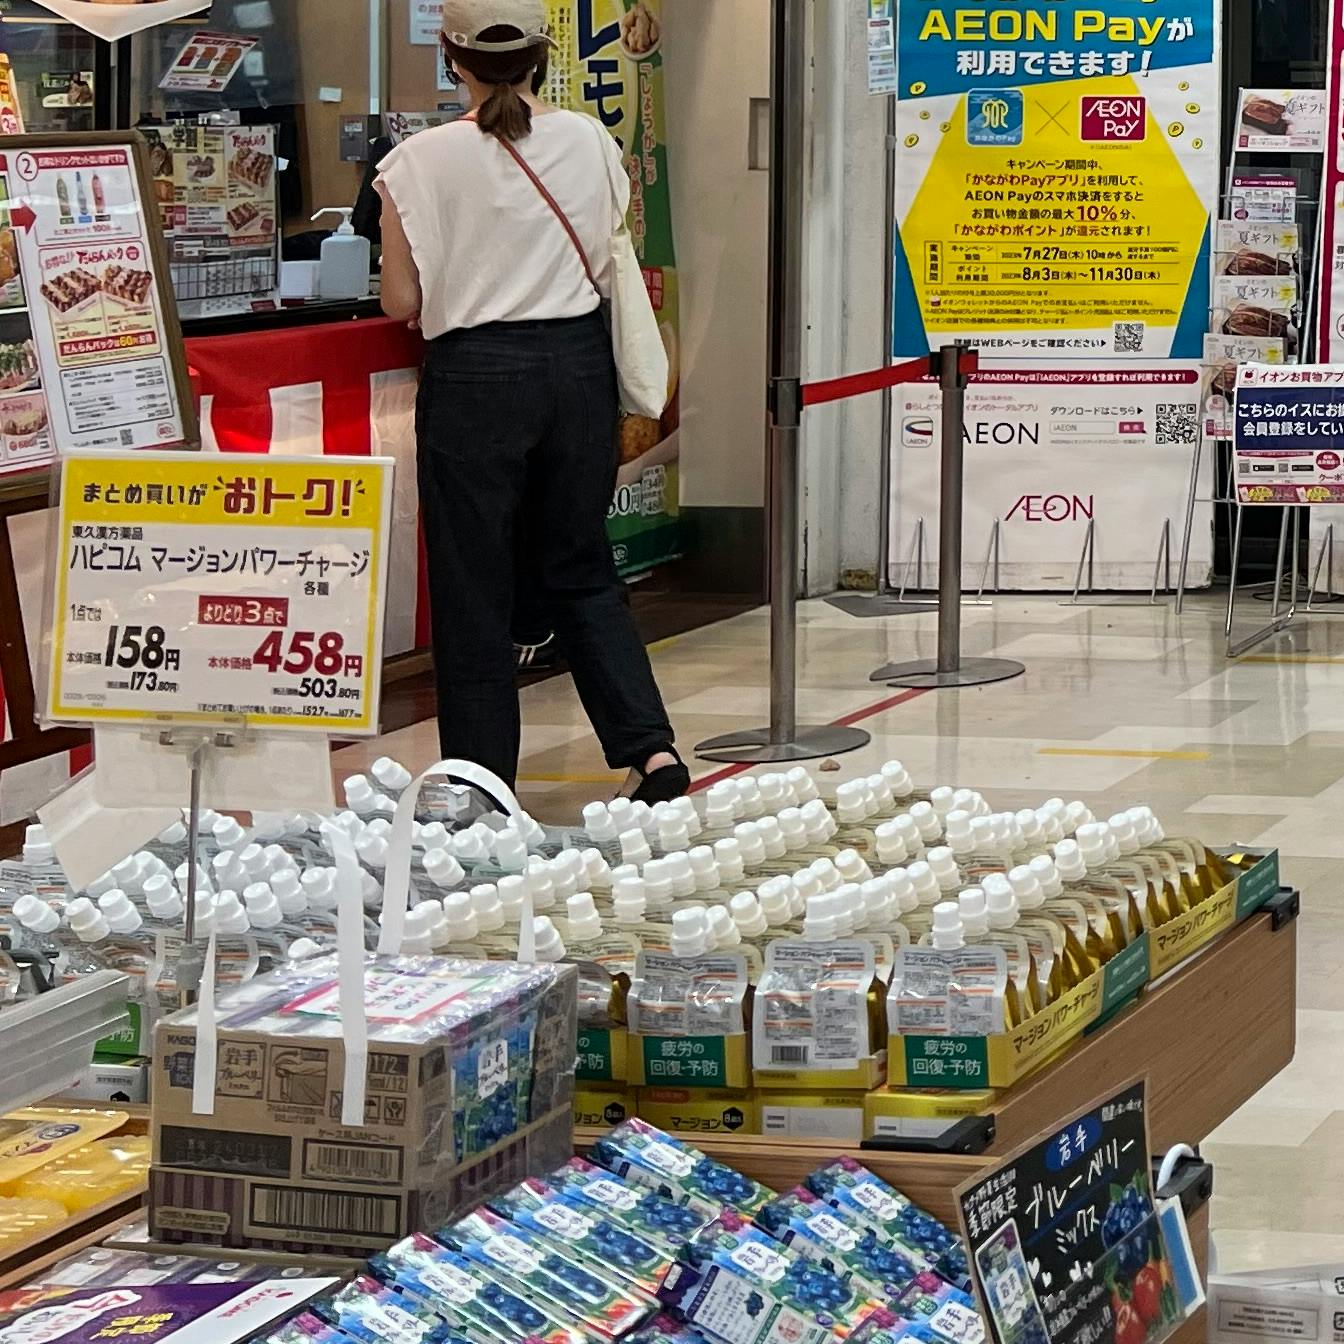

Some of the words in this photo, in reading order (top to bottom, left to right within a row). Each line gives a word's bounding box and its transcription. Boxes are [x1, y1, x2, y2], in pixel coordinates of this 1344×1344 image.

[918, 9, 1058, 42] AEON
[1073, 10, 1195, 46] Payが
[956, 49, 1153, 78] 利用できます!
[1084, 99, 1142, 120] AEON
[964, 190, 1004, 203] AEON
[1238, 230, 1279, 245] 夏ギフト
[1235, 284, 1276, 300] 夏ギフト
[1223, 344, 1264, 359] 夏ギフト
[1050, 405, 1136, 416] ダウンロードはこちら
[82, 482, 208, 506] まとめ買いが
[222, 476, 352, 517] おトク!
[1004, 494, 1095, 522] AEON
[69, 542, 142, 572] ハピコム
[151, 545, 370, 578] マージョンパワーチャージ
[303, 581, 330, 596] 各種
[104, 625, 181, 671] 158円
[252, 630, 363, 678] 458円
[660, 1040, 705, 1057] 疲労の
[923, 1040, 968, 1057] 疲労の
[670, 1116, 722, 1131] マージョン
